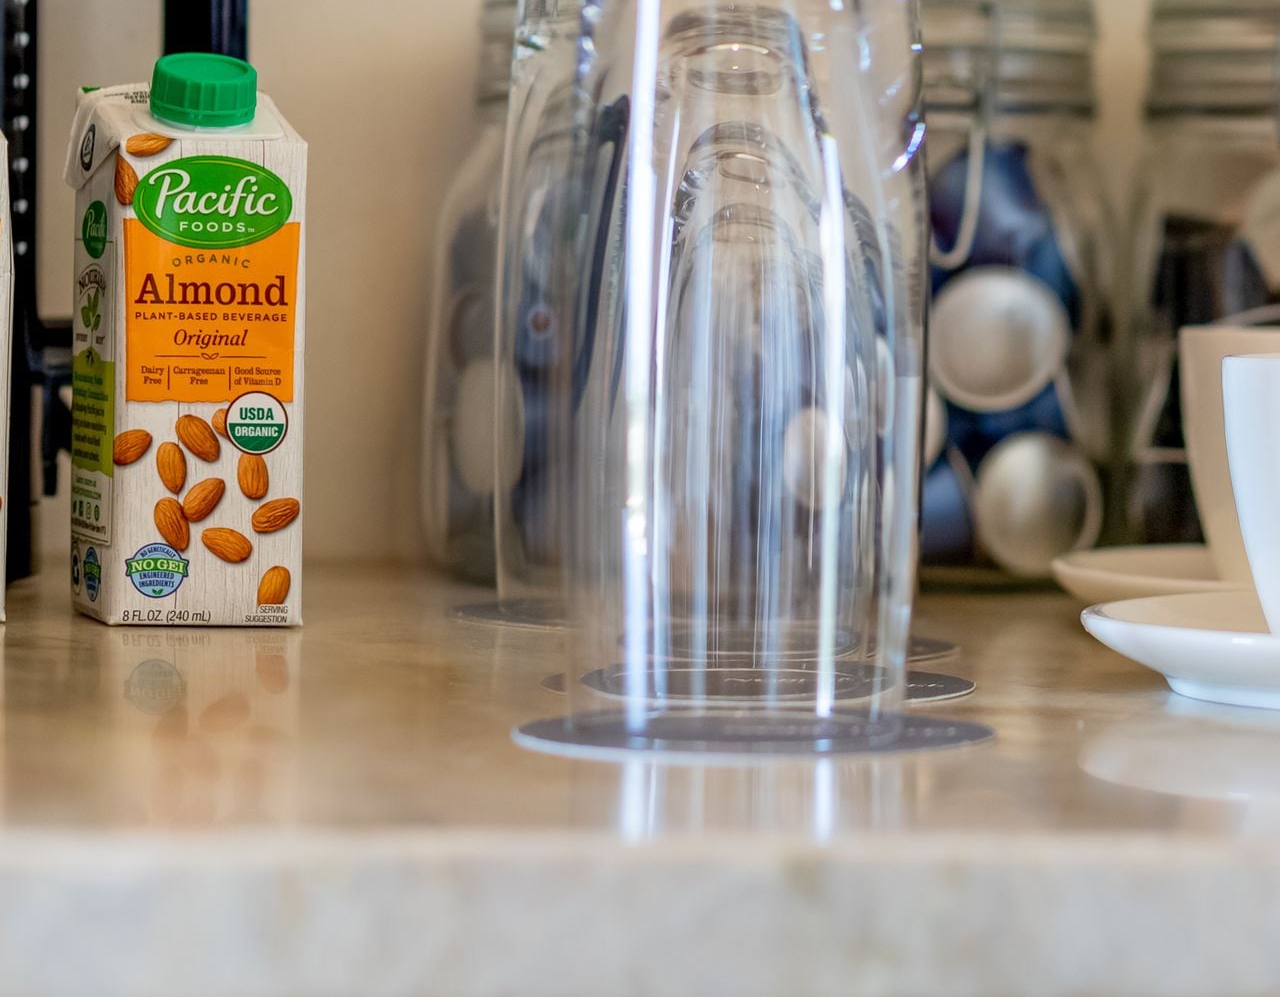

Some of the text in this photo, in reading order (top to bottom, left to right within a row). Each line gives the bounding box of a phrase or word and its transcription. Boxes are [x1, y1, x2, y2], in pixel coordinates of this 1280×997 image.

[148, 168, 279, 218] Pacific
[180, 222, 246, 232] FOODS
[172, 254, 250, 268] ORGANIC
[134, 273, 288, 306] Almond
[135, 312, 287, 322] PLANT-BASED BEVERAGE
[173, 329, 248, 350] Original
[141, 366, 164, 376] Dairy
[173, 366, 225, 376] Carrageenan
[234, 367, 281, 375] Good Source
[143, 376, 162, 384] Free
[234, 377, 242, 385] of
[244, 377, 273, 385] Vitamin
[239, 407, 274, 420] USDA
[235, 426, 278, 437] ORGANIC
[147, 546, 176, 558] GENETICALLY
[130, 559, 184, 573] NO GEI
[139, 580, 175, 588] INGREDIENTS
[259, 606, 288, 614] SERVING
[122, 610, 130, 621] 8
[166, 610, 189, 623] (240
[191, 611, 211, 623] mL)
[245, 615, 287, 623] SUGGESTION
